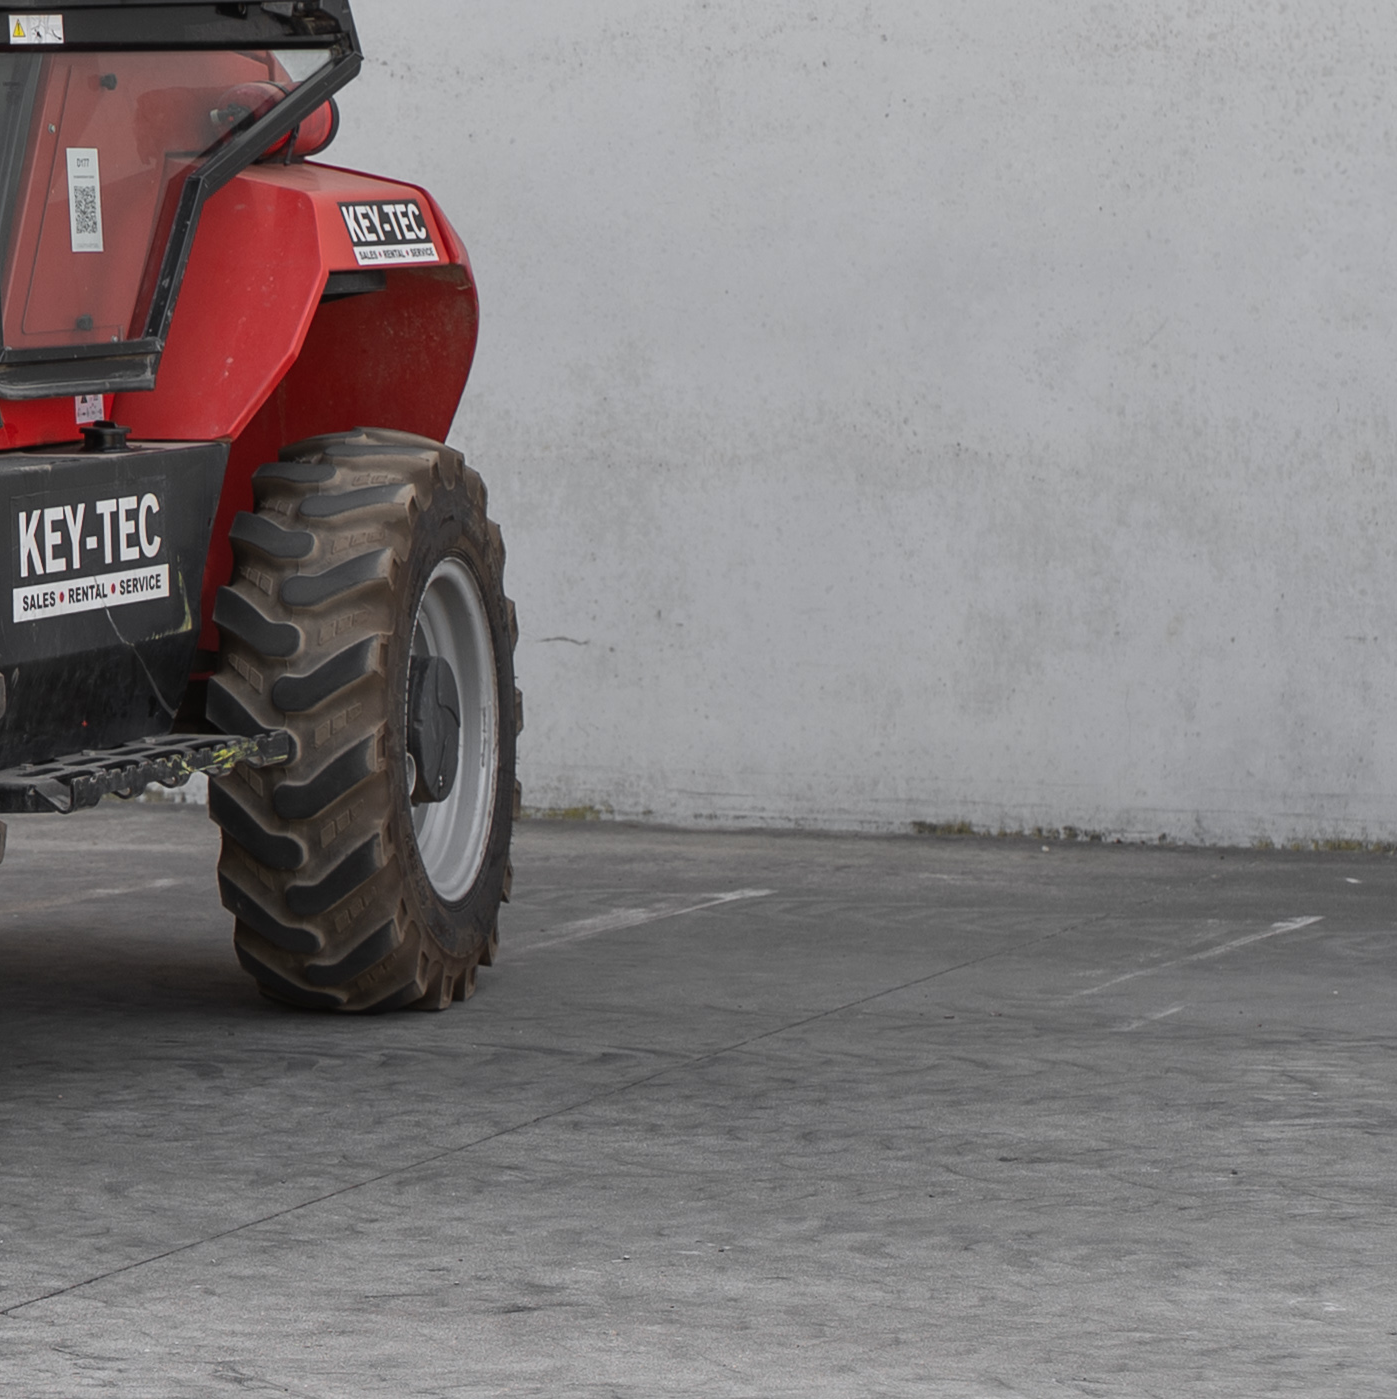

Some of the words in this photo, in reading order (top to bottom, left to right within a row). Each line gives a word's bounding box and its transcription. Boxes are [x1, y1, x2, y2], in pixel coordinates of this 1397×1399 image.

[341, 203, 427, 242] KEY-TEC
[359, 251, 378, 260] SALES
[382, 249, 406, 259] RENTAL
[410, 247, 435, 257] SERVICE
[18, 492, 162, 578] KEY-TEC
[22, 590, 56, 612] SALES
[68, 583, 108, 604] RENTAL
[119, 573, 162, 595] SERVICE
